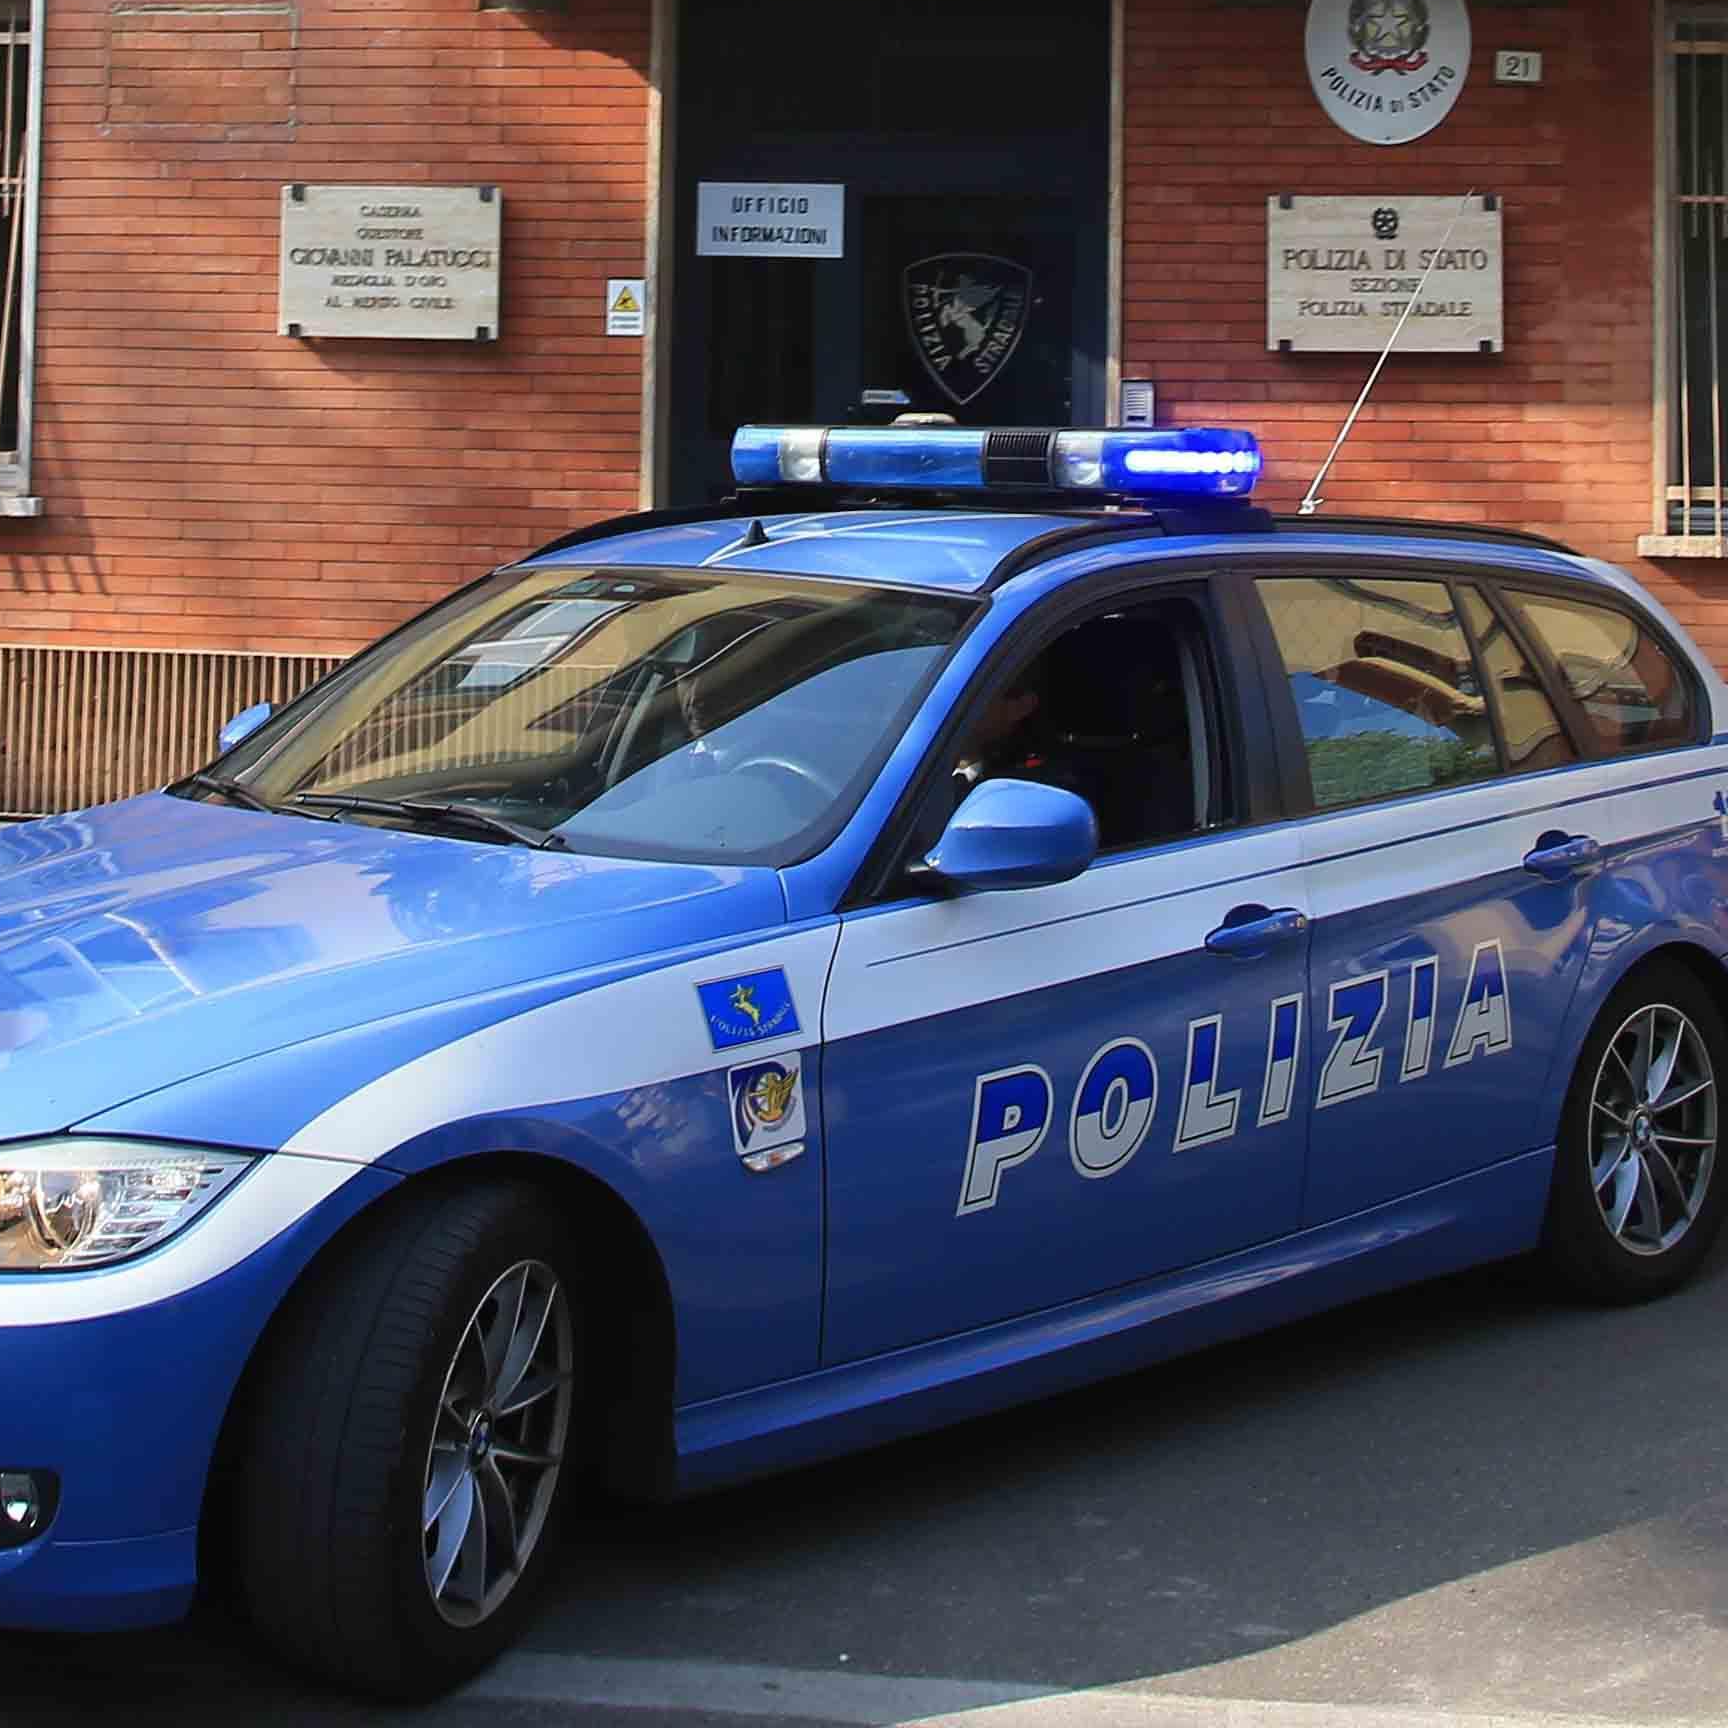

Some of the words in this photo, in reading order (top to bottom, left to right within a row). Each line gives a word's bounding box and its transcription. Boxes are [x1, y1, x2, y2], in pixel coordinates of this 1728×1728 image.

[1505, 56, 1529, 77] 21
[1321, 66, 1383, 112] POLIZIA
[1389, 100, 1404, 112] DI
[1407, 66, 1456, 108] STATO
[360, 205, 423, 218] CASERNA
[731, 196, 809, 214] UFFICIO
[356, 227, 424, 240] QUESTORE
[712, 226, 828, 245] INFORMAZIONI
[290, 248, 374, 266] GIOVANNI
[384, 248, 492, 267] PALATUCCI
[1282, 249, 1371, 270] POLIZIA
[1384, 249, 1406, 270] DI
[1418, 249, 1488, 270] STATO
[330, 274, 395, 287] MEDAGLIA
[403, 275, 447, 287] D'ORO
[1351, 278, 1422, 293] SEZIONE
[324, 296, 343, 308] AL
[353, 296, 401, 309] MERITO
[409, 297, 457, 309] CIVILE
[1297, 301, 1368, 317] POLIZIA
[956, 937, 1513, 1217] POLIZIA
